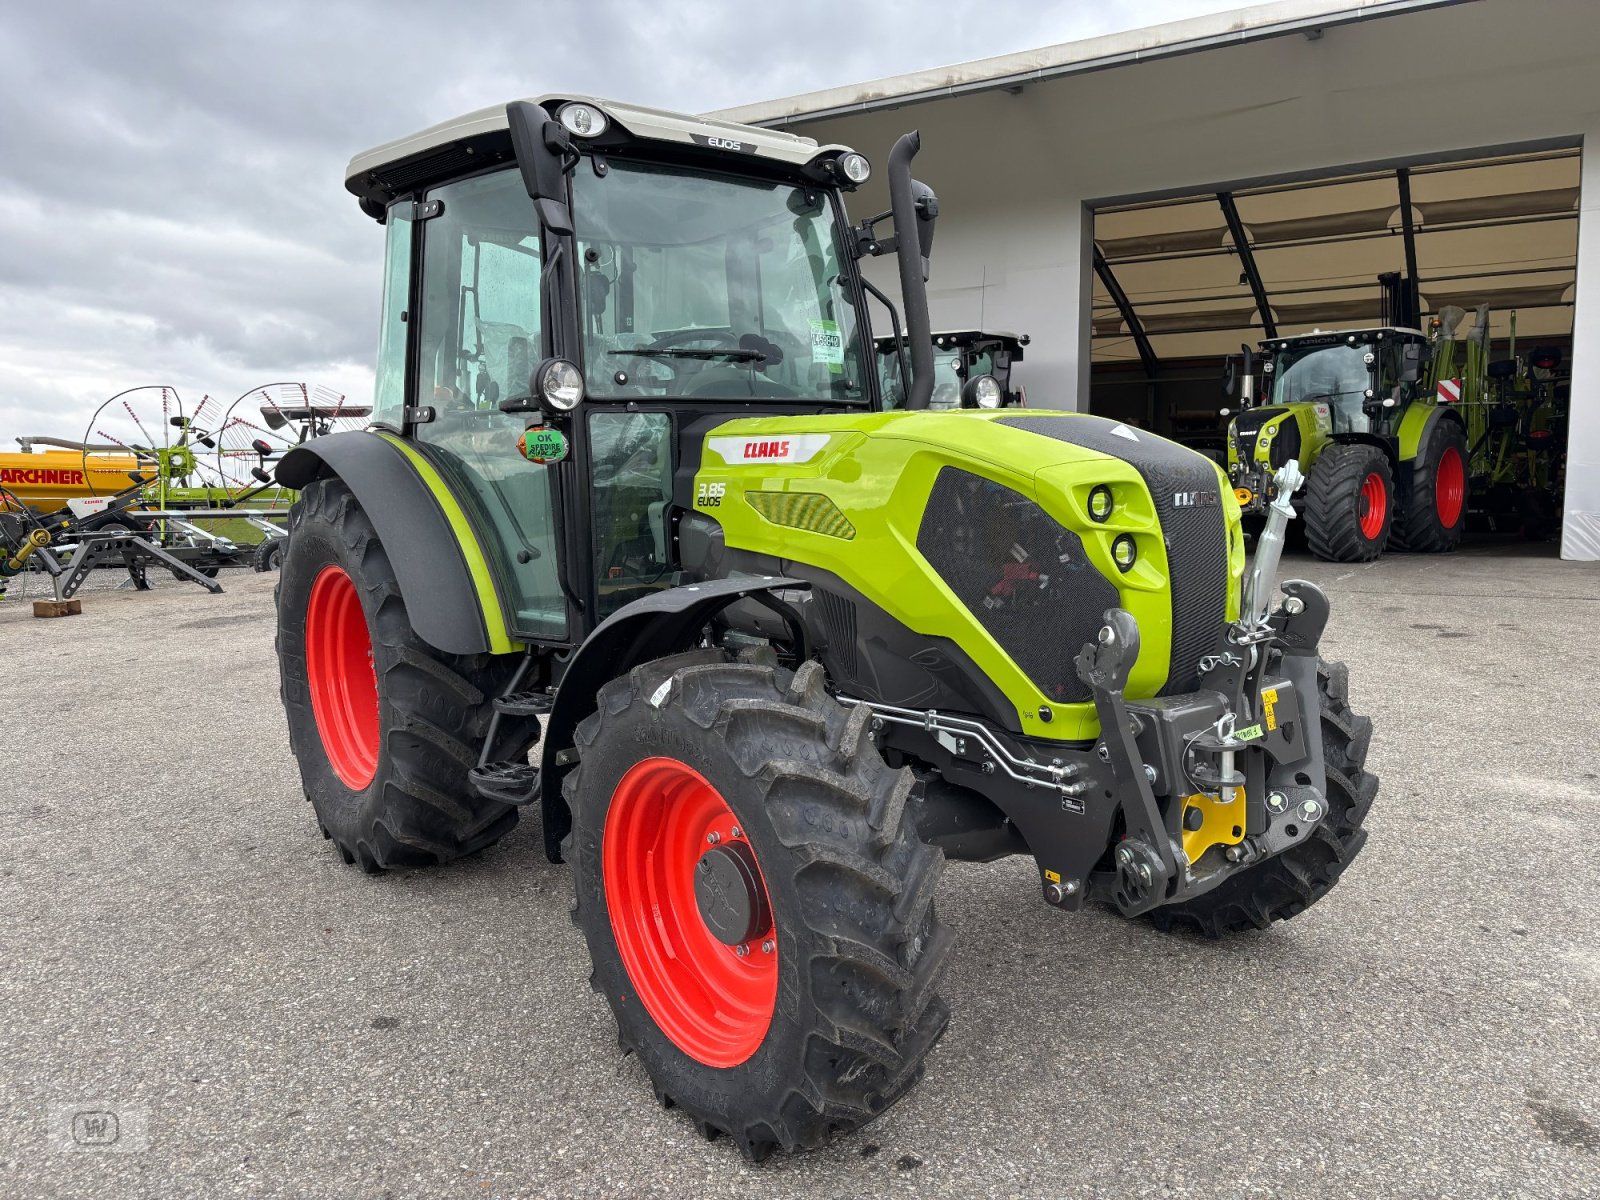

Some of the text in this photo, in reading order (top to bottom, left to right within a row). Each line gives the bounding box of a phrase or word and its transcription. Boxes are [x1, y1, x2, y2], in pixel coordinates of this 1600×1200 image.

[707, 137, 741, 151] ELIOS
[537, 434, 552, 442] OK
[743, 441, 790, 459] CLAAS
[698, 483, 727, 497] 3.85
[697, 496, 721, 507] ELIOS
